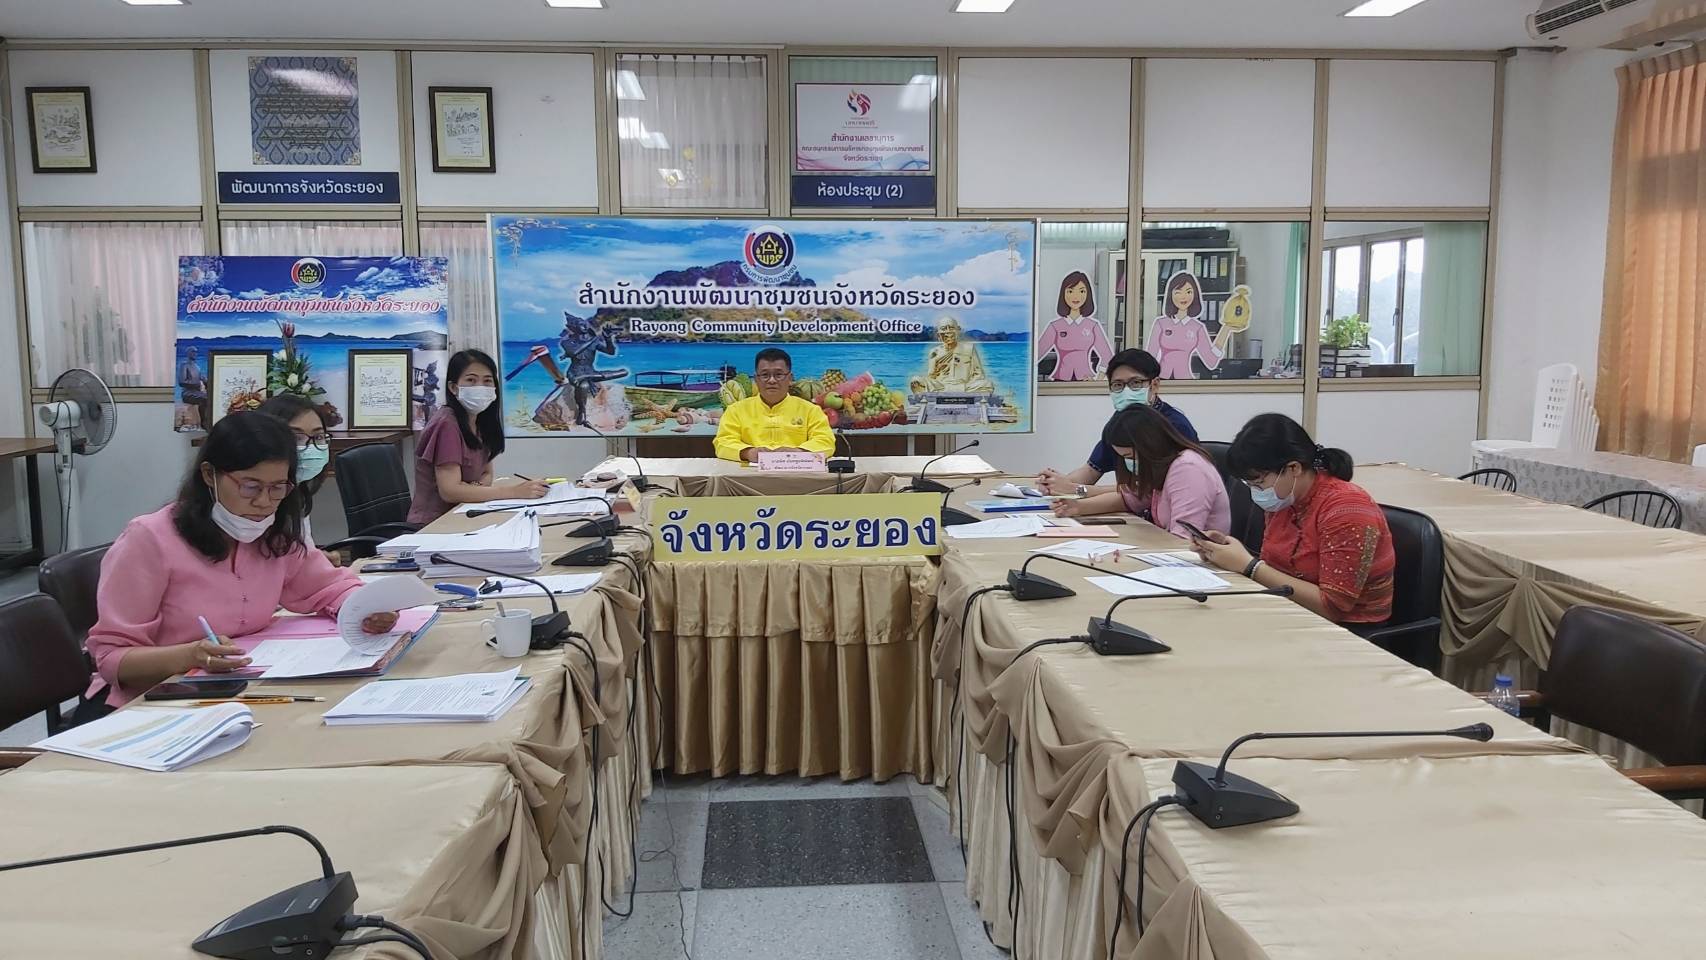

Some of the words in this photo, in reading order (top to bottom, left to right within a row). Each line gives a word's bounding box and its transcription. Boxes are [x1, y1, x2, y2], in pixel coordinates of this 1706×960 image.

[231, 179, 384, 194] พัฒนาการจังหวัดระยอง
[817, 183, 881, 199] ห้องประชุม
[885, 184, 904, 197] (2)
[188, 292, 441, 317] สำนักงานพัฒนาชุมชนจังหวัดระยอง
[579, 281, 974, 312] สำนักงานพัฒนาชุมชนจังหวัดระยอง
[631, 319, 686, 335] Rayong
[692, 319, 775, 335] Community
[780, 319, 875, 335] Development
[879, 319, 921, 332] Office
[660, 507, 937, 553] จังหวัดระยอง
